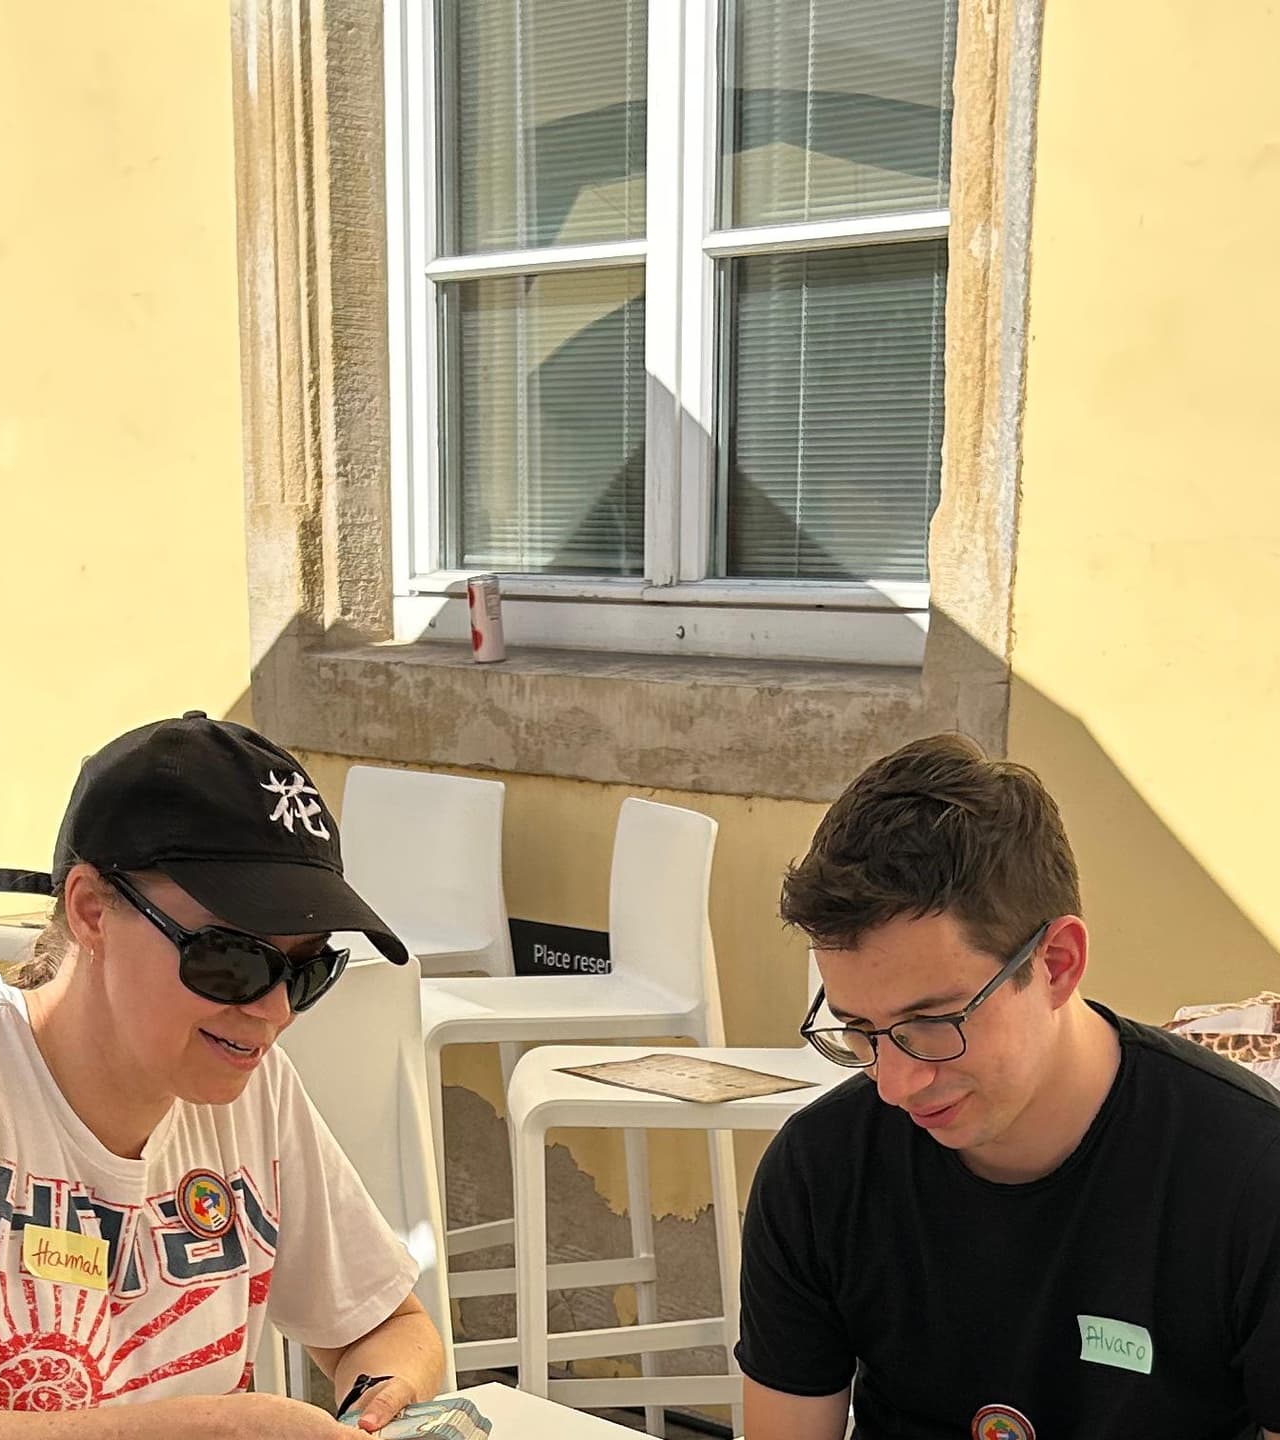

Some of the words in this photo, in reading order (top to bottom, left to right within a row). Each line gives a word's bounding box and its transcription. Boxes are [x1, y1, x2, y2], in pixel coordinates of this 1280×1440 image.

[260, 770, 331, 841] 花
[533, 944, 570, 970] Place
[32, 1238, 102, 1277] Hannah
[1085, 1325, 1146, 1361] Alvaro
